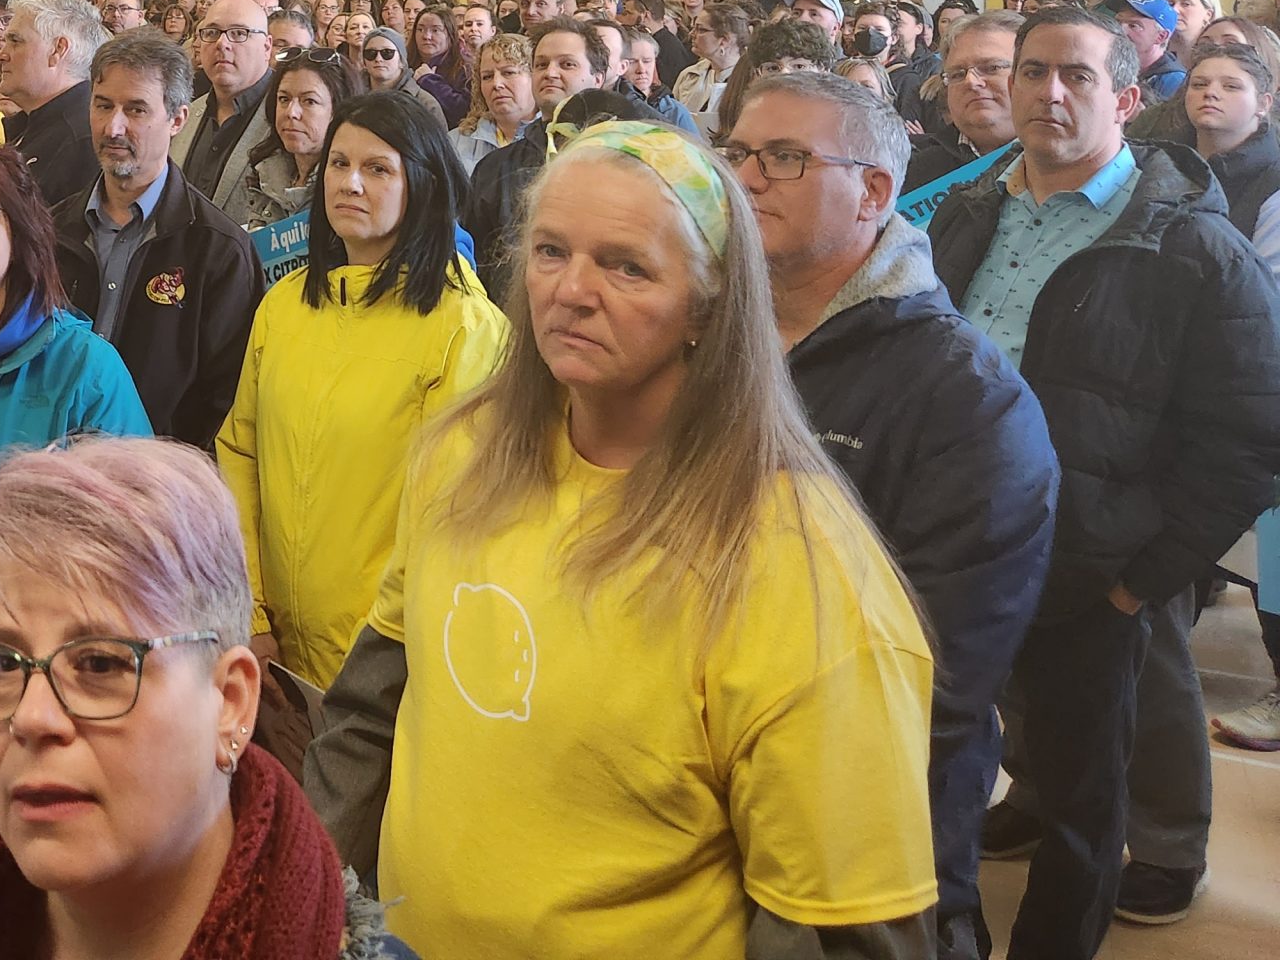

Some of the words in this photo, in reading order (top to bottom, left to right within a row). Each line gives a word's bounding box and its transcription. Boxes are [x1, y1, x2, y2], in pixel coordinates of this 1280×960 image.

[899, 191, 949, 222] ATIO
[270, 227, 280, 252] À
[280, 221, 301, 252] qui
